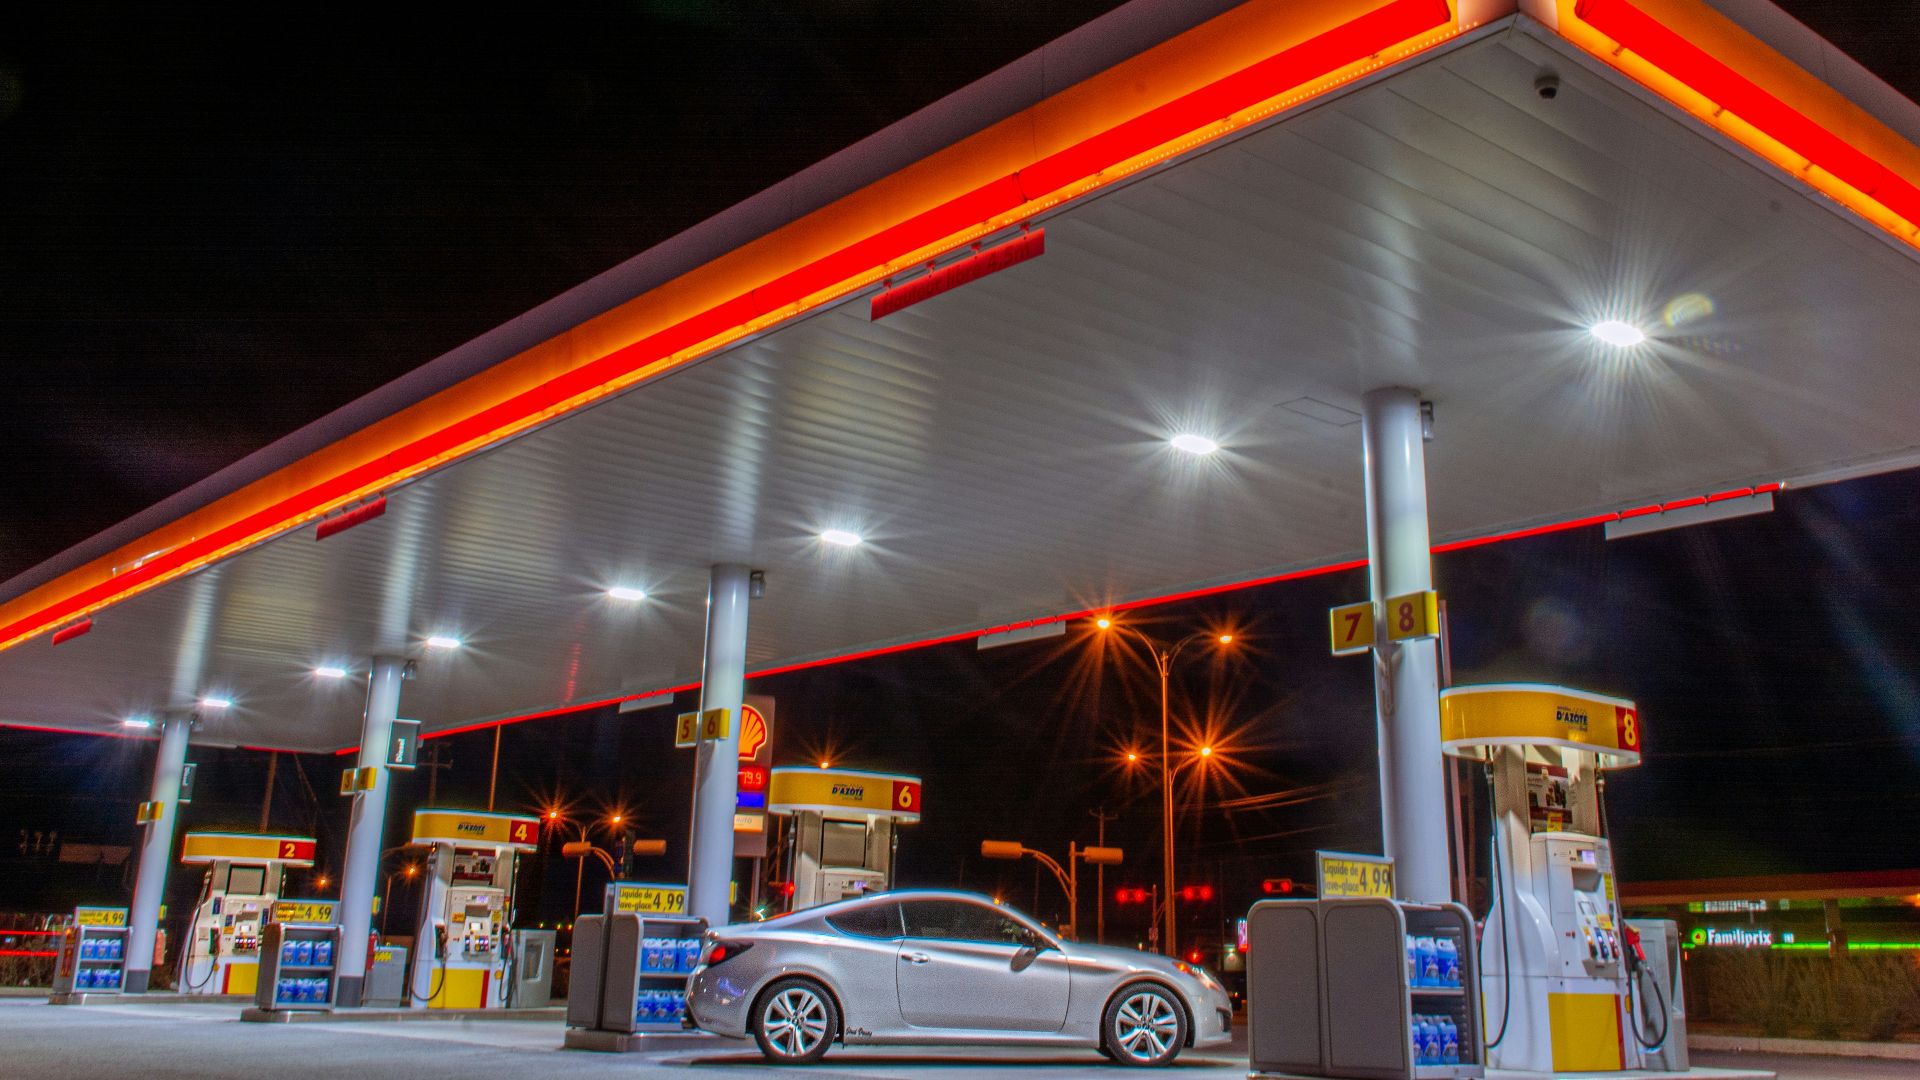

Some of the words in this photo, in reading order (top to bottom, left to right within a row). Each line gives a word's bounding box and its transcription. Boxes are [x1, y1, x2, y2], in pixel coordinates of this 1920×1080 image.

[1345, 612, 1362, 642] 7
[1399, 602, 1414, 632] 8
[682, 720, 689, 739] 5
[707, 715, 716, 735] 6
[1624, 713, 1636, 747] 8
[899, 785, 912, 808] 6
[514, 824, 528, 841] 4
[285, 843, 296, 858] 2
[1707, 928, 1772, 948] Familiprix
